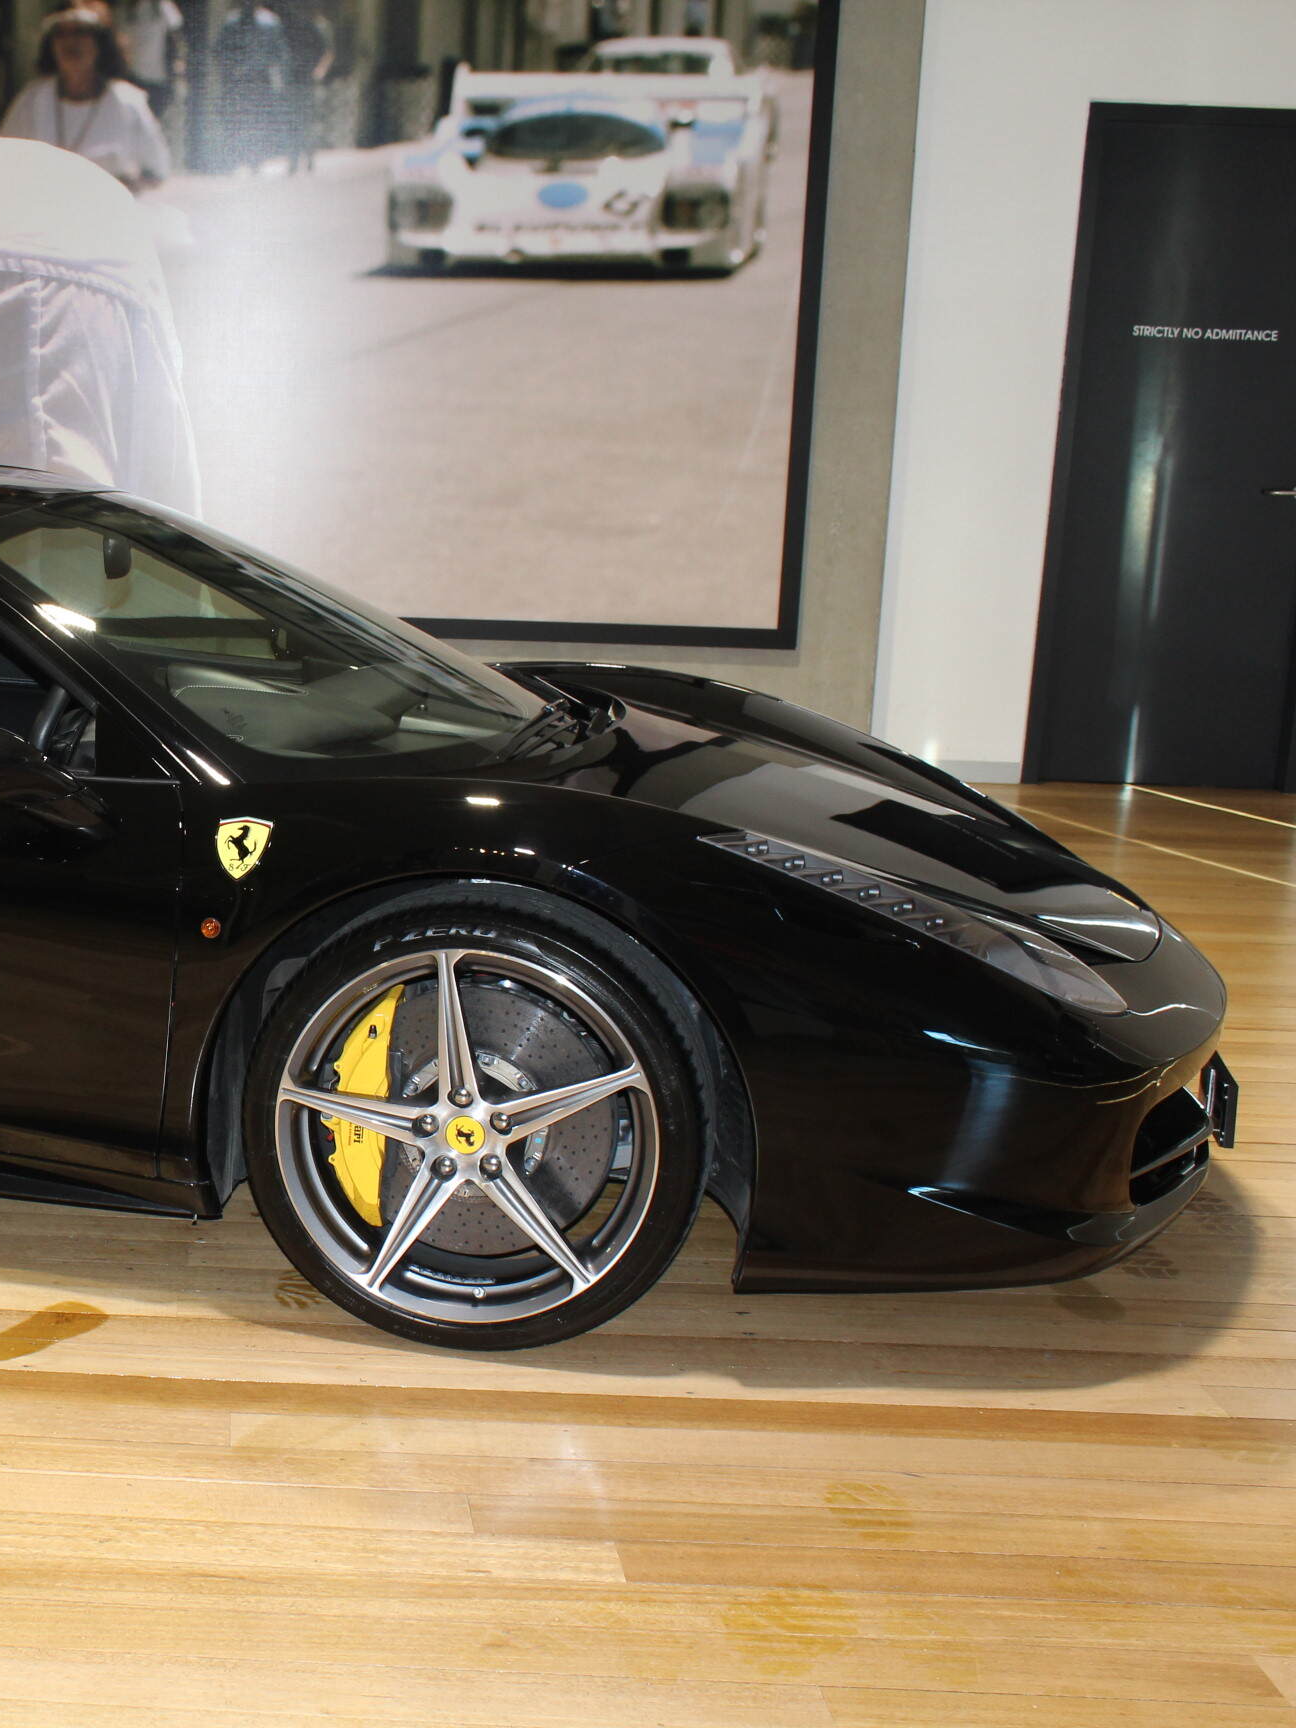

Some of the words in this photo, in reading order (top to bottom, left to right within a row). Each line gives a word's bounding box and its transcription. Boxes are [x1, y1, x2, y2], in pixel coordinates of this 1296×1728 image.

[1132, 325, 1180, 338] STRICTLY
[1182, 327, 1202, 339] NO
[1204, 328, 1278, 341] ADMITTANCE
